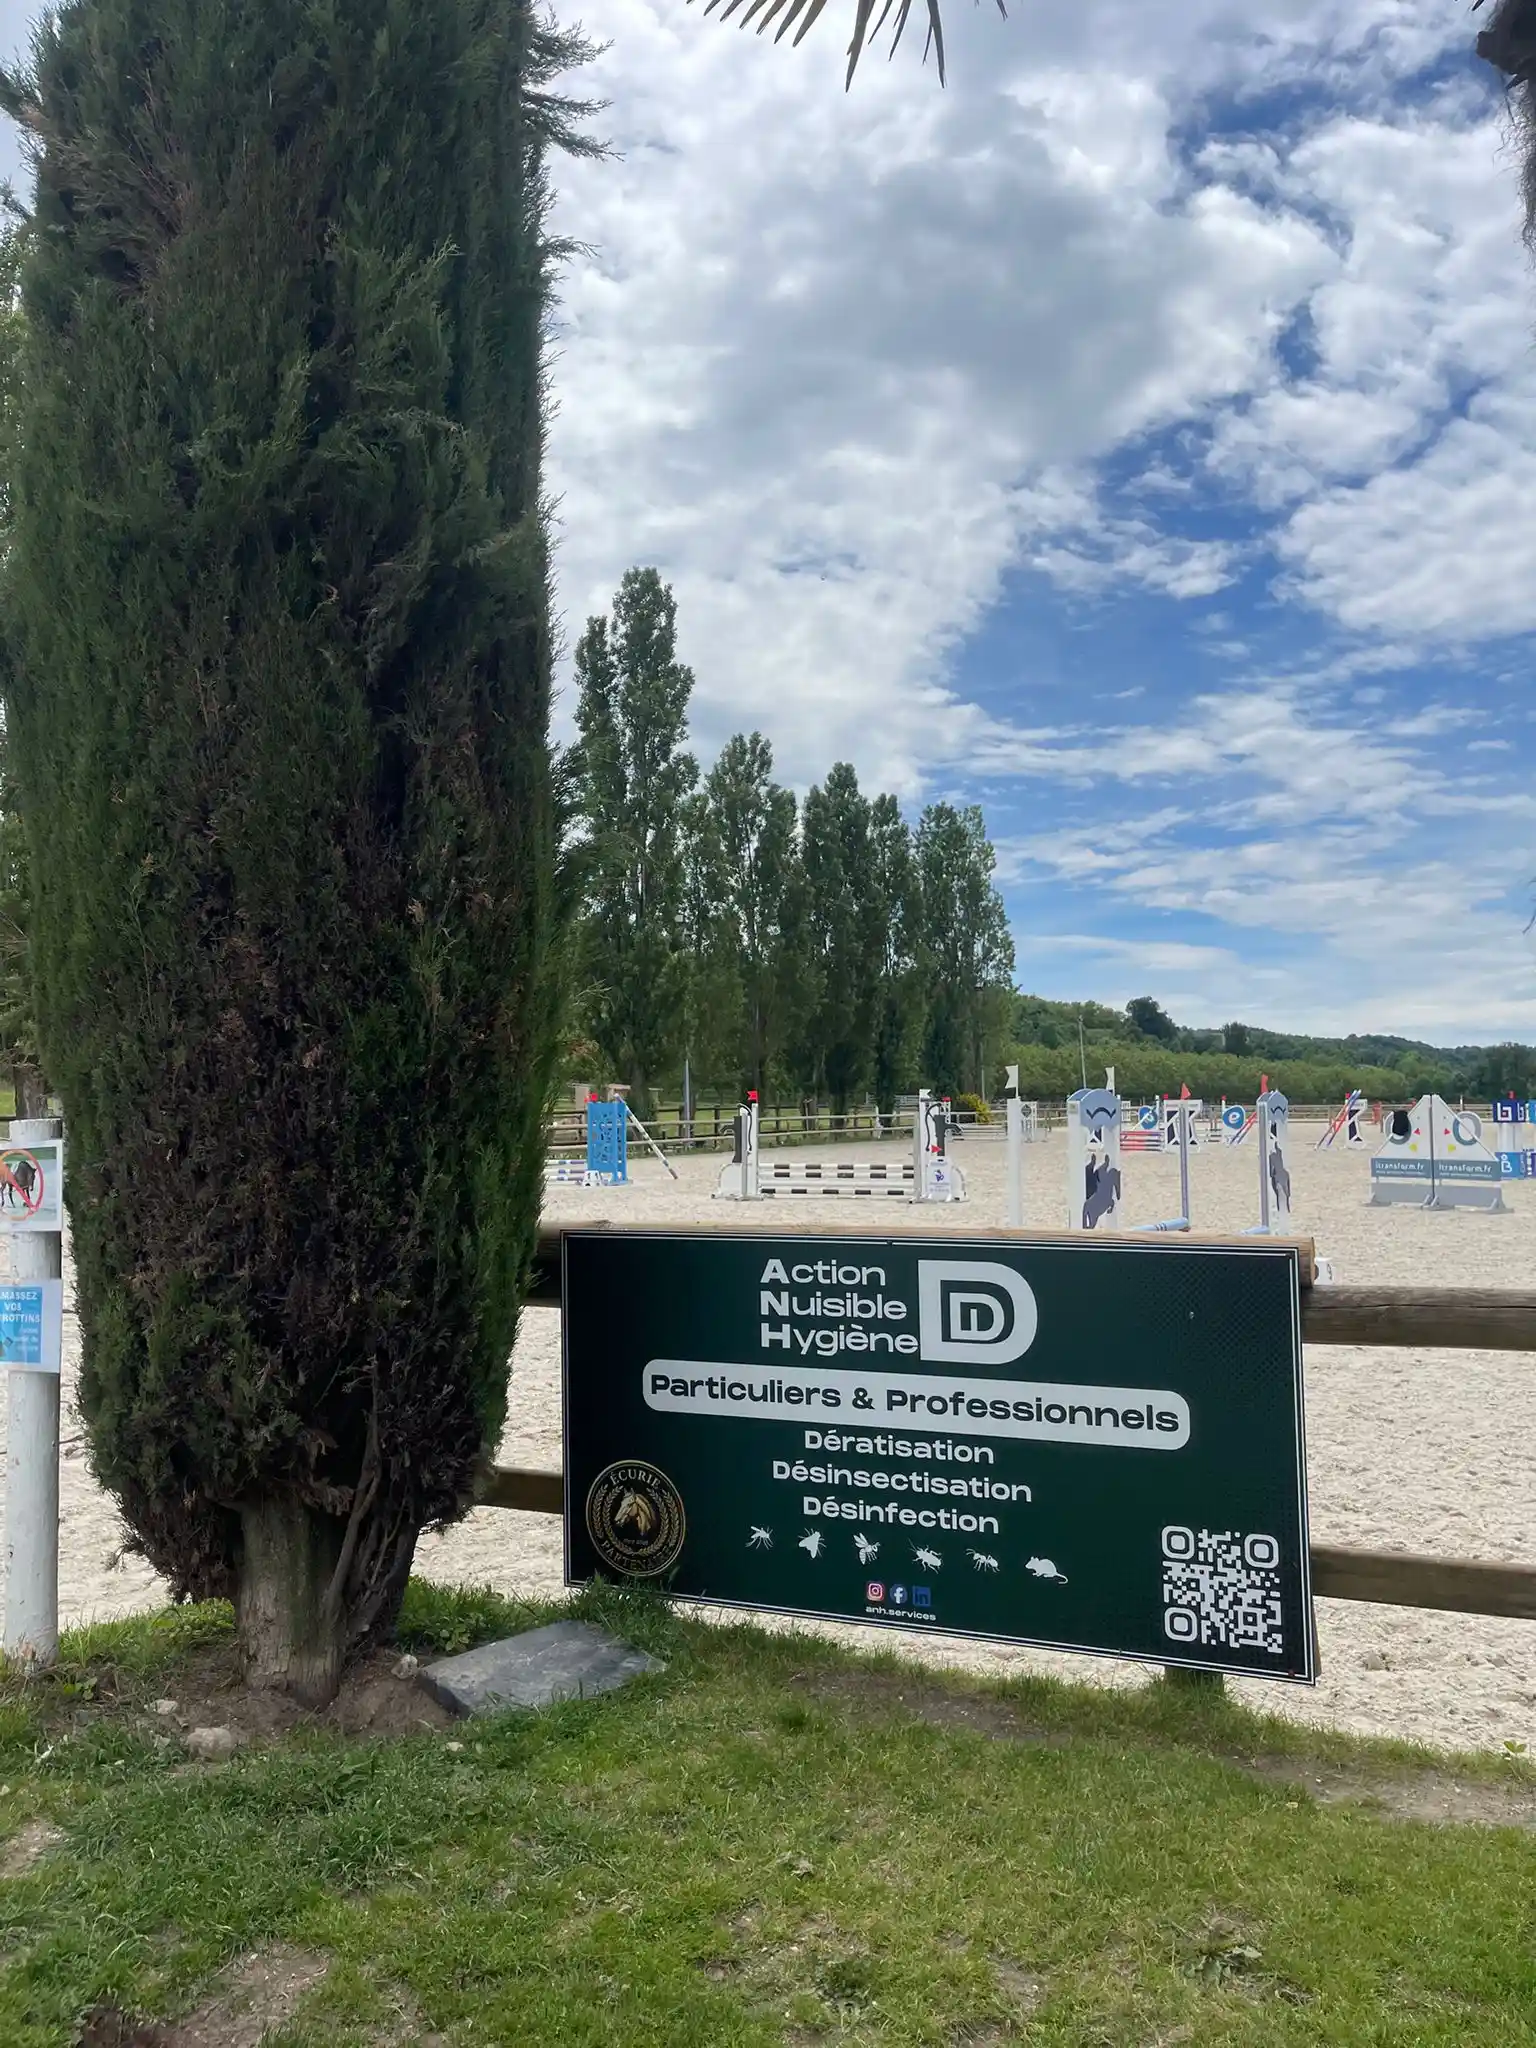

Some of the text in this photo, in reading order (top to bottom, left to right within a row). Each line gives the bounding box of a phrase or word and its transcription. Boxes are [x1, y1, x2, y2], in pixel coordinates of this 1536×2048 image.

[760, 1258, 886, 1286] Action
[0, 1291, 38, 1301] MASSEZ
[760, 1290, 907, 1320] Nuisible
[0, 1313, 41, 1323] ROTTINS
[760, 1322, 919, 1356] Hygiène
[650, 1374, 1180, 1432] Particuliers & Professionnels
[804, 1429, 995, 1464] Dératisation
[609, 1468, 661, 1488] ÉCURIE
[772, 1460, 1032, 1502] Désinsectisation
[803, 1496, 999, 1534] Désinfection
[600, 1540, 676, 1570] PARTENAE
[865, 1605, 937, 1621] anh.services
